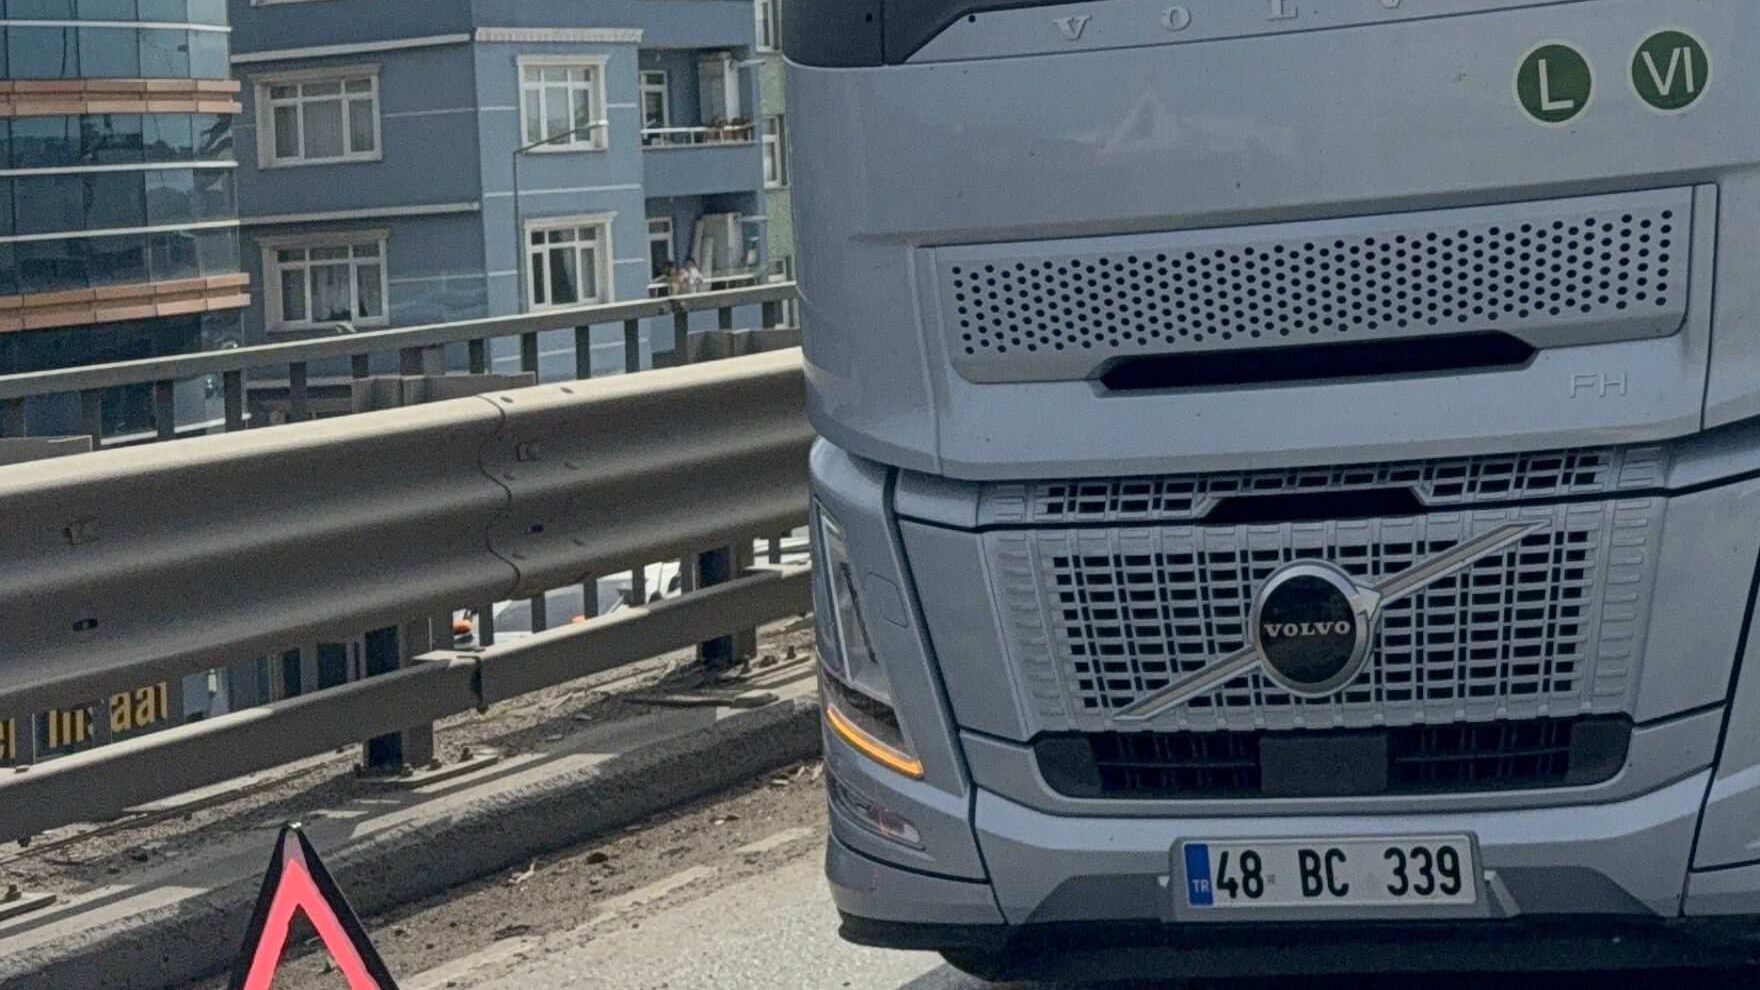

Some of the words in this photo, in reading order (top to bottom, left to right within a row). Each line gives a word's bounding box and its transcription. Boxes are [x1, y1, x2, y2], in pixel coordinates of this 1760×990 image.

[1538, 58, 1574, 111] L
[1569, 371, 1628, 399] FH
[1263, 620, 1351, 638] VOLVO
[1191, 879, 1210, 893] TR
[1216, 849, 1264, 899] 48
[1297, 847, 1350, 898] BC
[1383, 845, 1462, 897] 339
